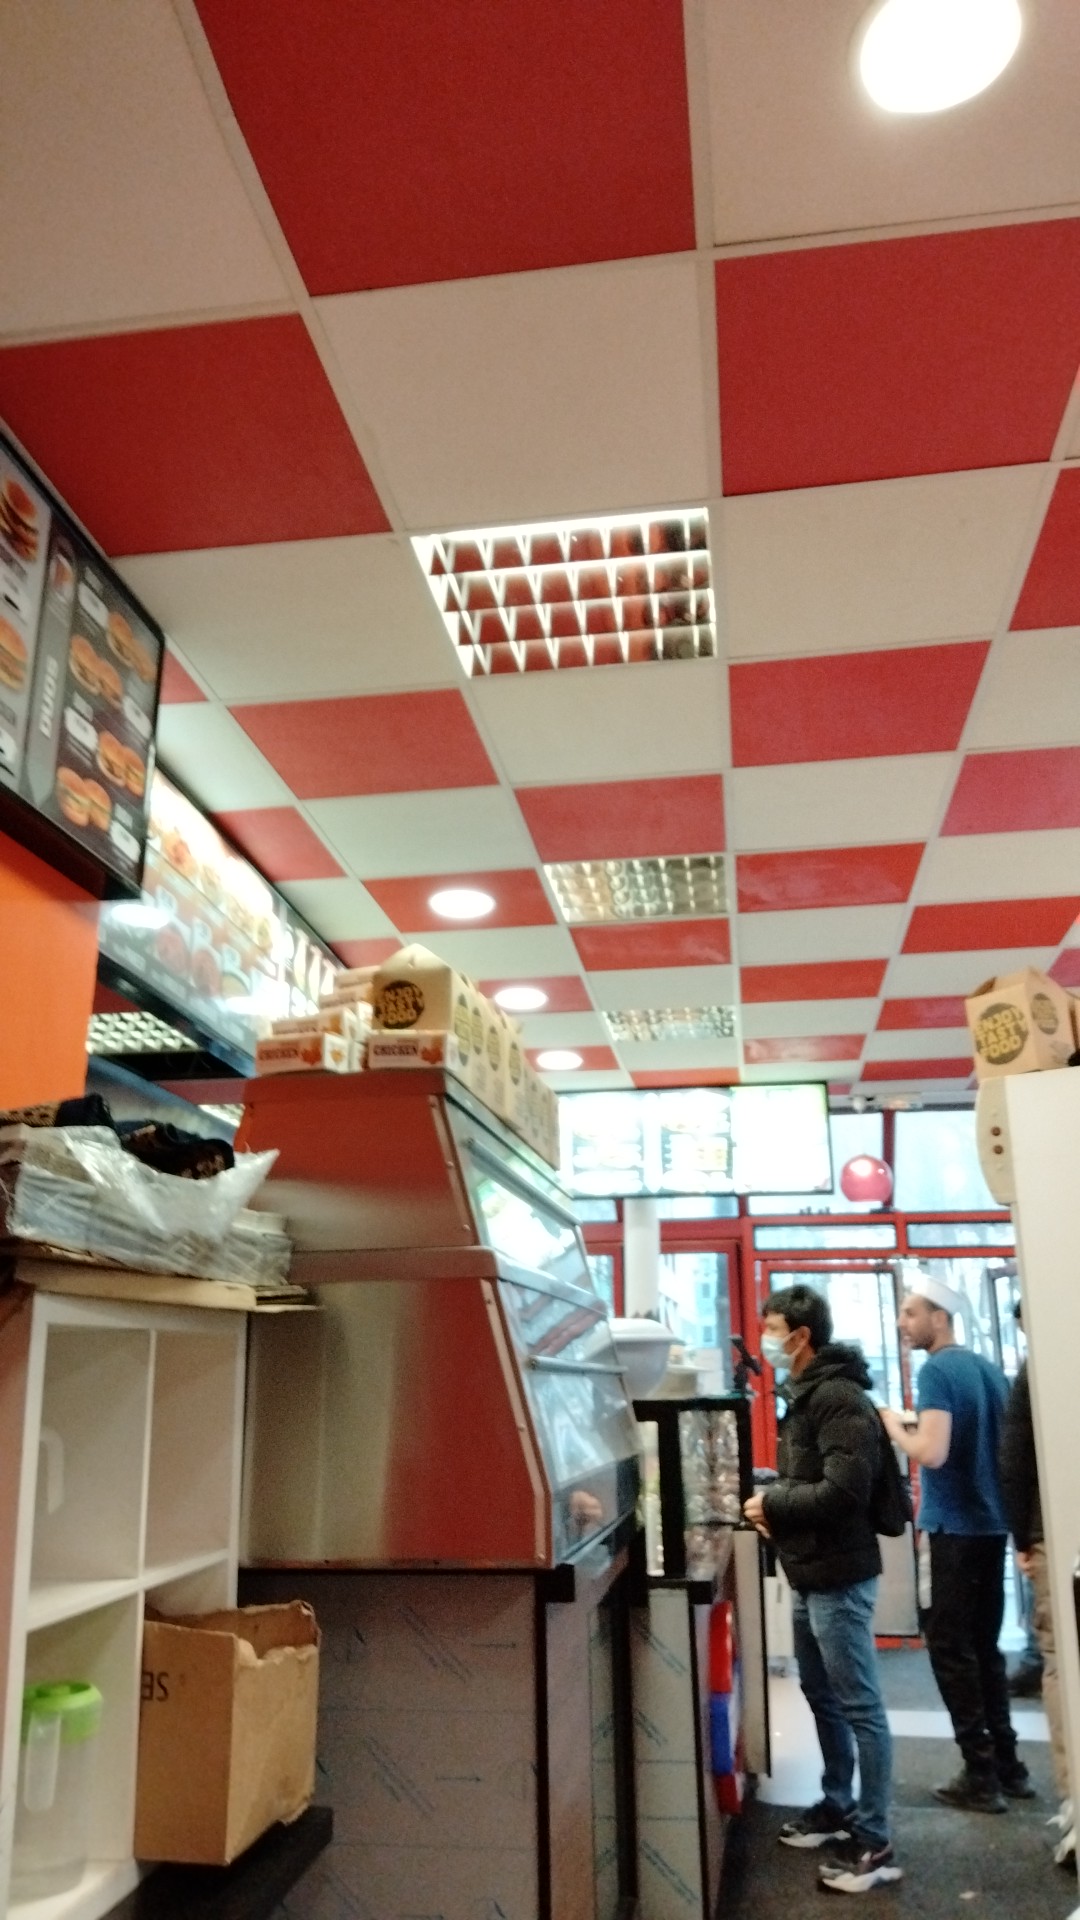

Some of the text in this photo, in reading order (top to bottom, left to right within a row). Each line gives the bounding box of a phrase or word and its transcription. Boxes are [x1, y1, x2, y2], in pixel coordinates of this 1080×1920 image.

[976, 1006, 1023, 1031] ENJOY
[976, 1020, 1028, 1044] TASTY
[980, 1035, 1021, 1059] FOOD
